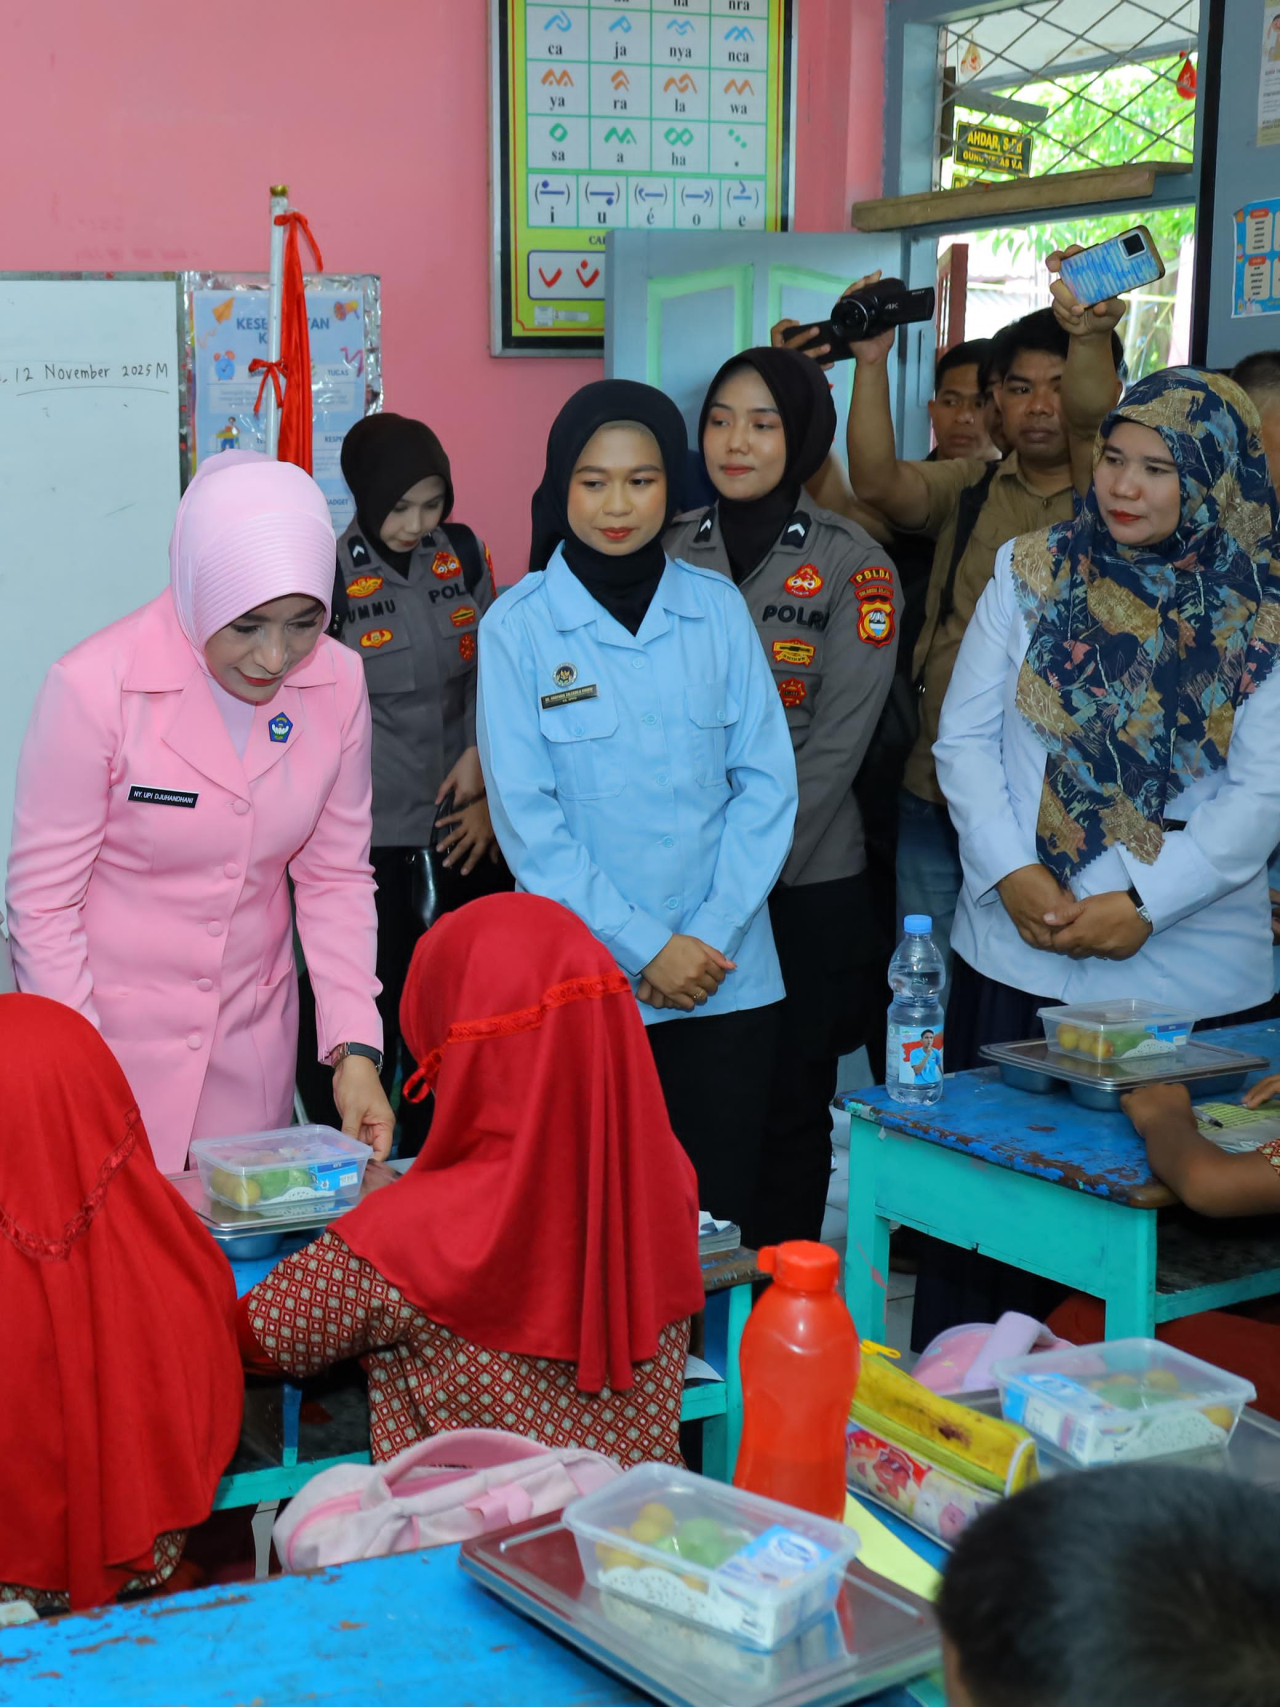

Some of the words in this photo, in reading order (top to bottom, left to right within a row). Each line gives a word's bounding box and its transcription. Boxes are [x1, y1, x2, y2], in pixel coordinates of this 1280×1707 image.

[548, 44, 563, 56] ca
[614, 41, 627, 59] ja
[669, 45, 692, 59] nya
[728, 50, 749, 63] nca
[549, 96, 565, 111] ya
[613, 99, 627, 110] ra
[675, 98, 686, 113] la
[730, 103, 748, 115] wa
[967, 130, 1000, 152] AHDAR,
[551, 150, 566, 162] sa
[617, 152, 625, 163] a
[671, 151, 687, 167] ha
[550, 206, 555, 223] i
[598, 211, 607, 224] u
[692, 213, 701, 226] o
[738, 214, 747, 227] e
[884, 302, 899, 310] 4K
[15, 366, 34, 383] 12
[44, 363, 111, 381] November
[855, 568, 890, 583] POLDA
[428, 582, 469, 604] POL
[346, 599, 396, 624] UMMU
[154, 793, 194, 804] DJUHANDHANI
